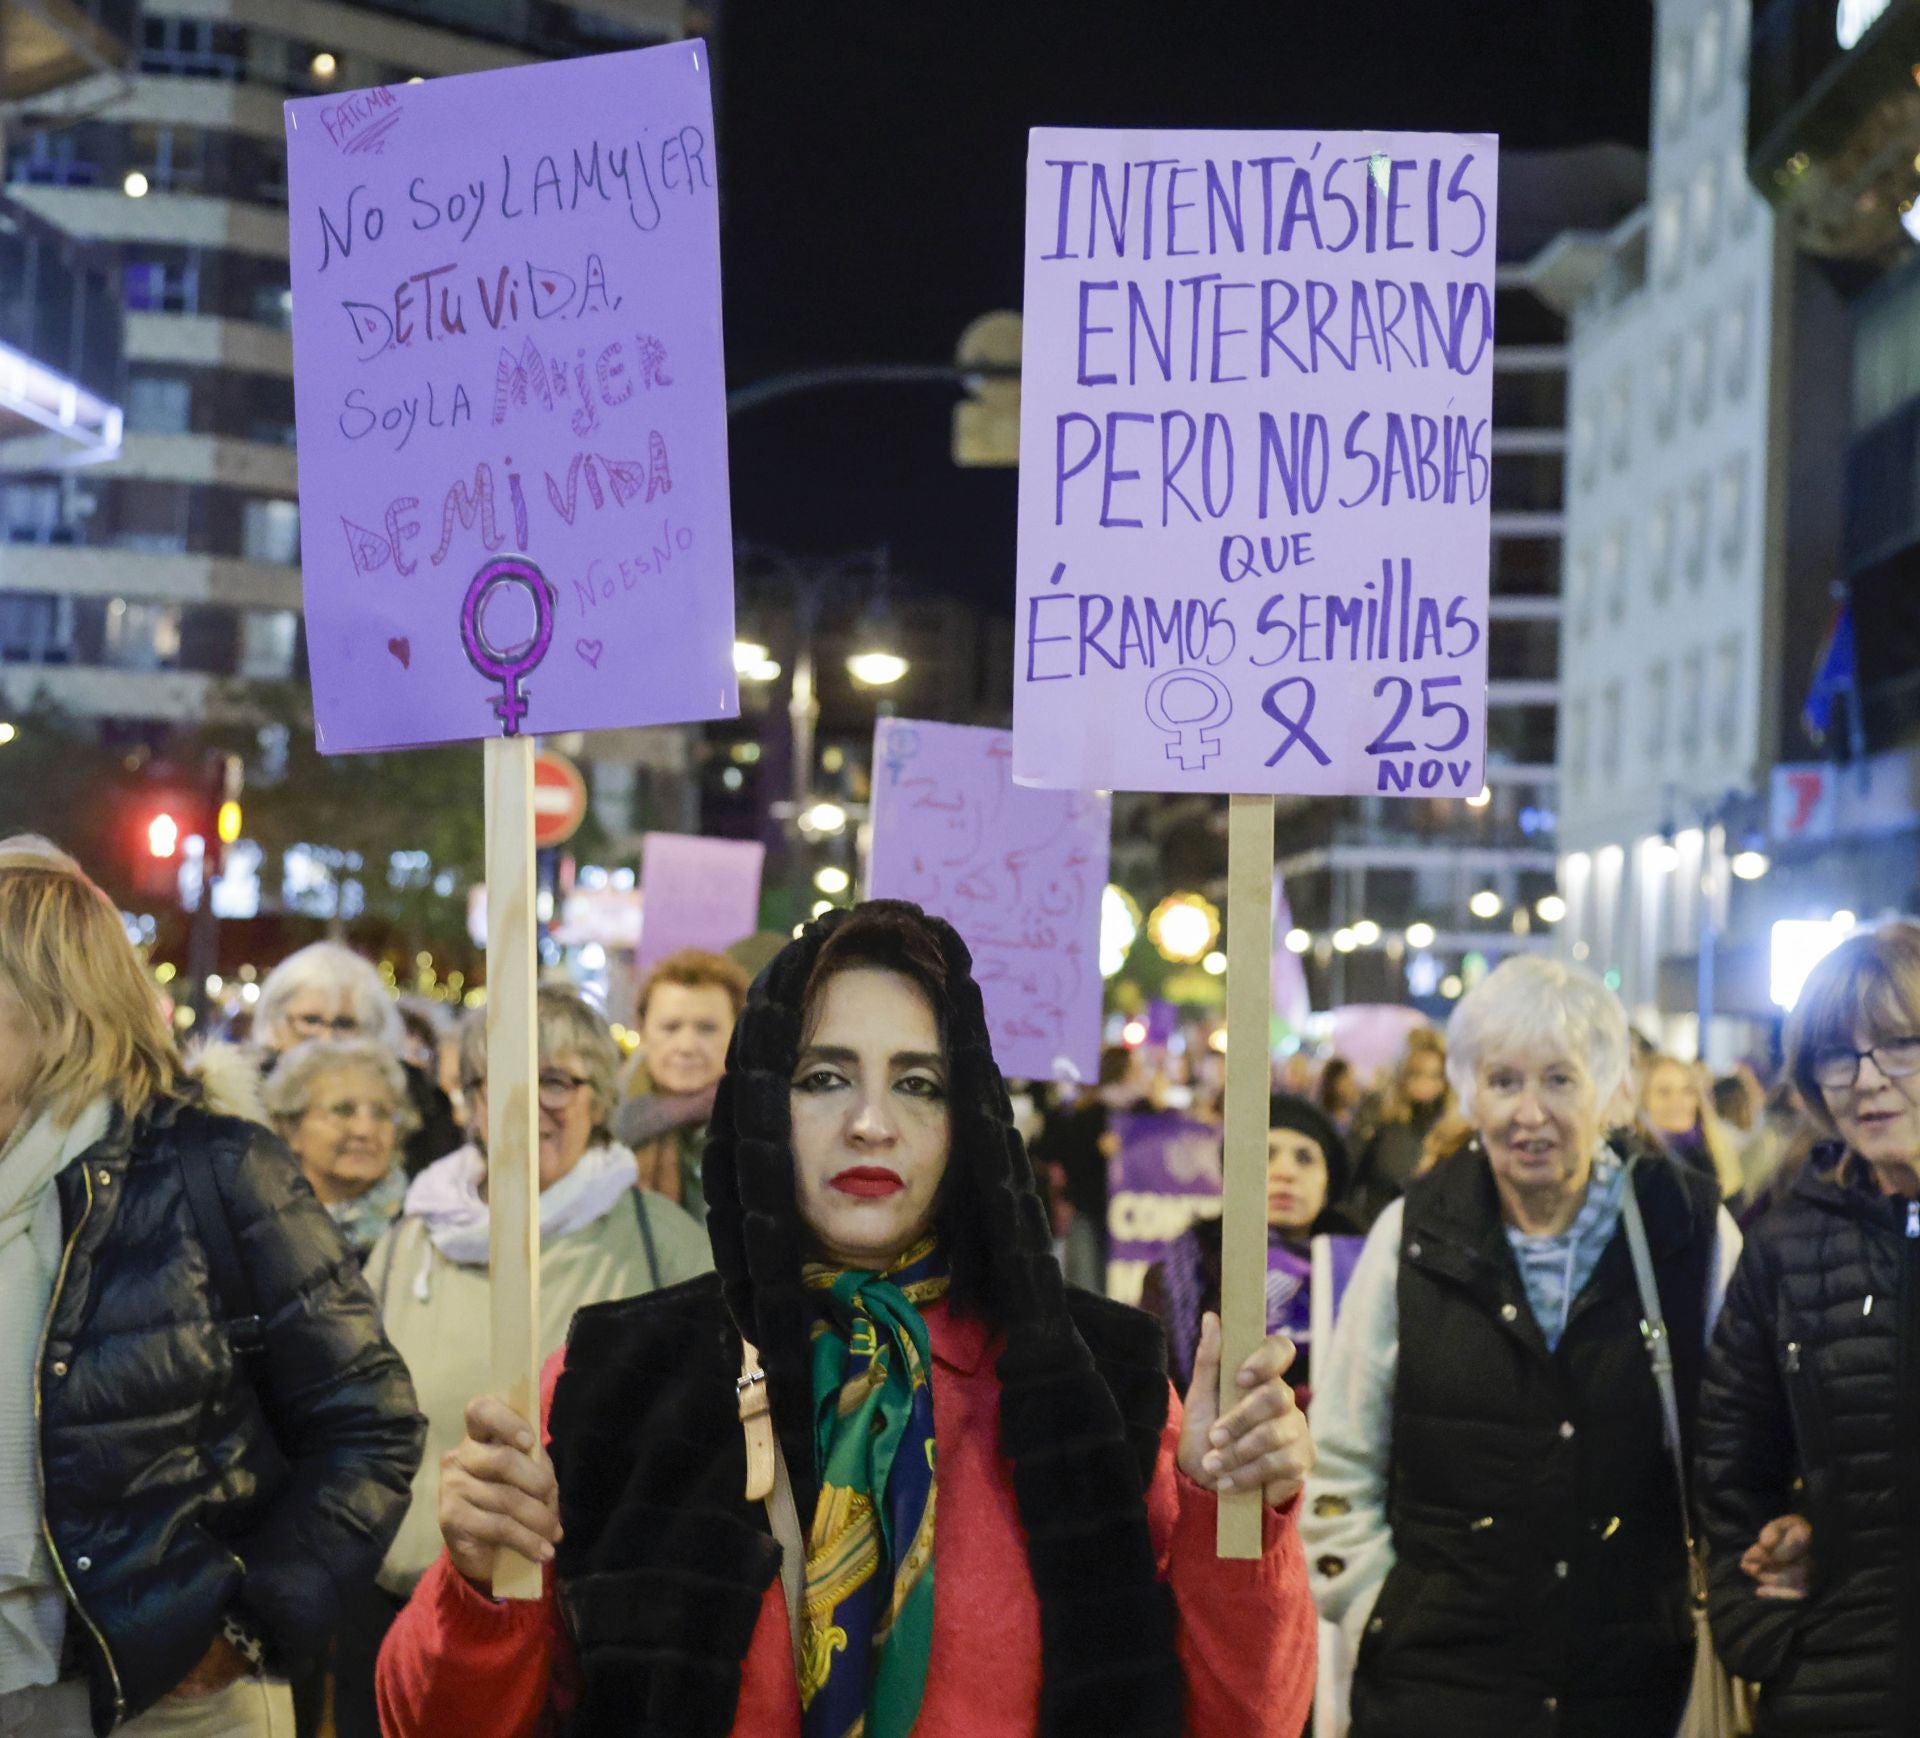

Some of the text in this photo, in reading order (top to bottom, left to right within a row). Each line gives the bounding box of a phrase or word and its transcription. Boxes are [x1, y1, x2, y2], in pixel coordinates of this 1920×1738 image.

[409, 177, 485, 242] Soy
[1040, 141, 1486, 261] INTENTÁSTEIS
[339, 388, 418, 452] Soy
[1056, 396, 1489, 529] PERO NO SABÍAS
[339, 496, 420, 577] DE
[1219, 532, 1315, 583] QUE
[1026, 561, 1236, 682] ÉRAMOS
[1364, 674, 1470, 755] 25
[1377, 759, 1472, 791] NOV
